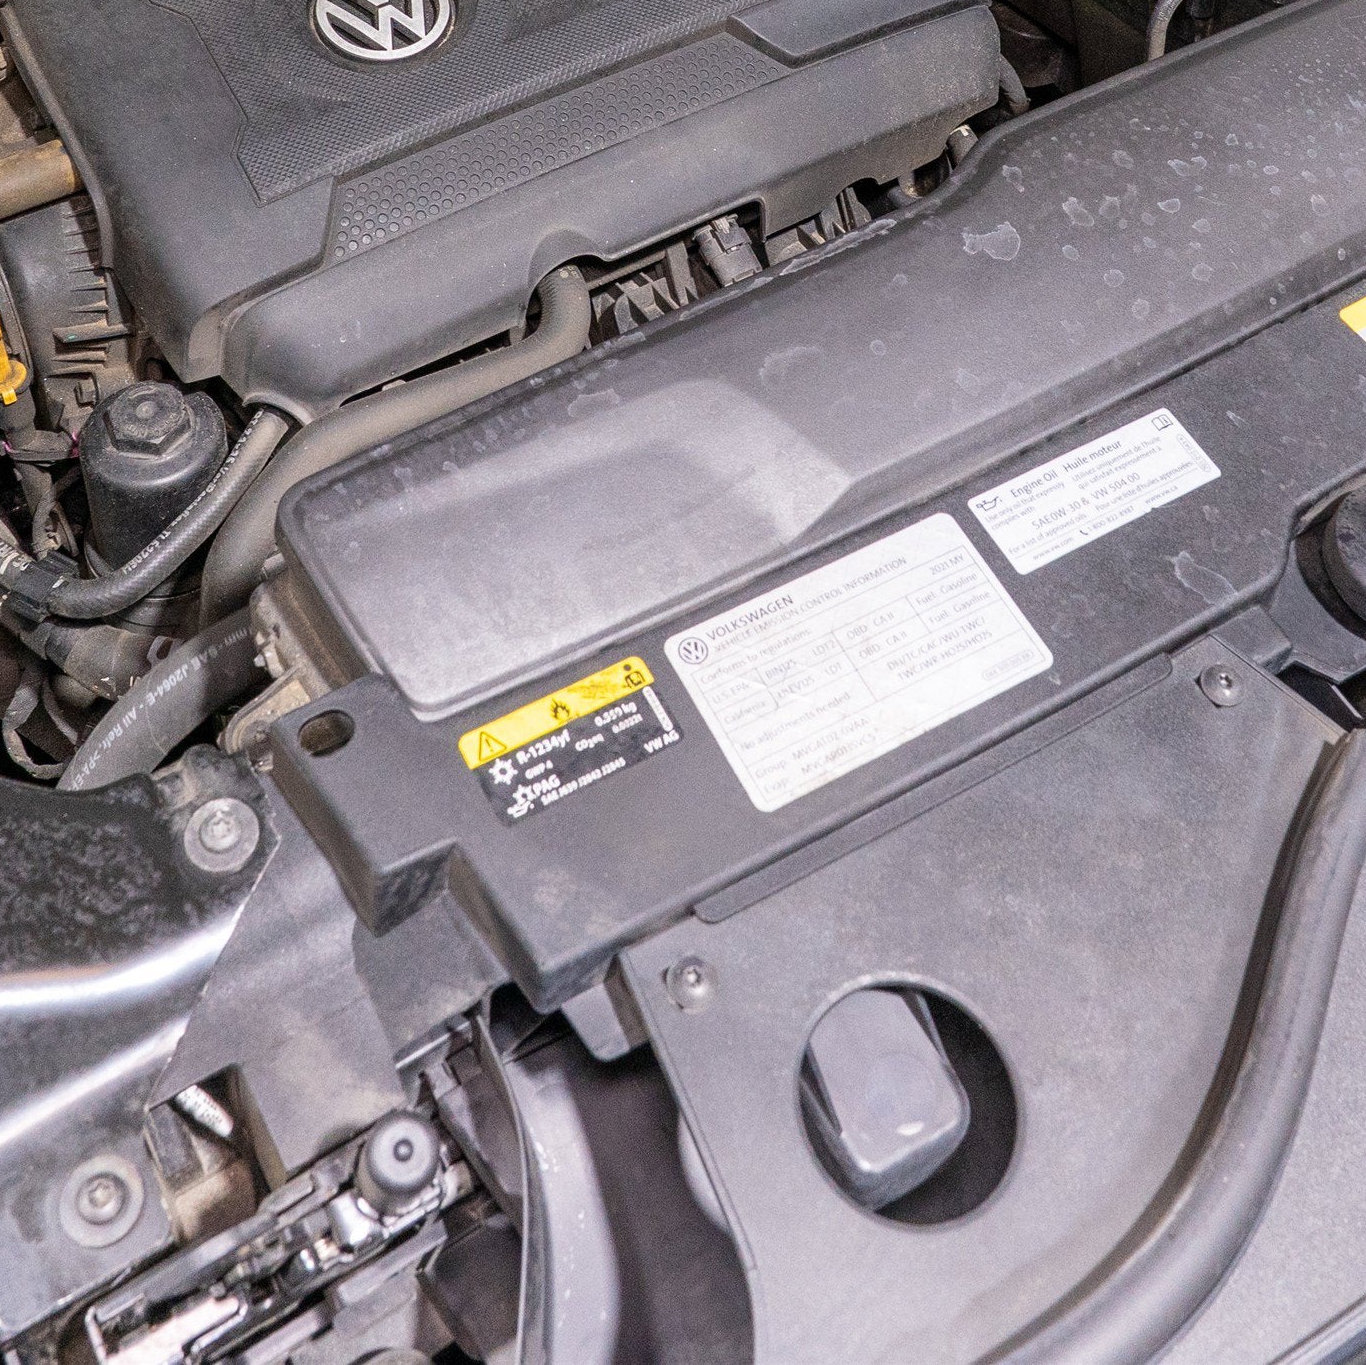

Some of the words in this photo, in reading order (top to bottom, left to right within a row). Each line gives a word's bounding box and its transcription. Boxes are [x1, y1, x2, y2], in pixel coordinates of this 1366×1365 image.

[1131, 443, 1142, 452] de
[1009, 476, 1045, 500] Engine
[1041, 469, 1058, 482] Oil
[1061, 454, 1089, 472] Huile
[1086, 439, 1122, 460] moteur
[997, 505, 1014, 517] only
[1011, 500, 1022, 509] oil
[1020, 494, 1036, 505] that
[1034, 480, 1066, 500] expressly
[1077, 480, 1091, 491] qui
[1079, 496, 1090, 506] &
[1089, 487, 1109, 501] VW
[1107, 477, 1128, 492] 504
[1125, 471, 1141, 483] 00
[990, 512, 1020, 531] complies
[1018, 505, 1035, 516] with
[1095, 500, 1111, 512] Pour
[1008, 544, 1021, 555] For
[1024, 537, 1036, 546] list
[1035, 532, 1045, 541] of
[1042, 517, 1075, 538] approved
[928, 560, 950, 575] 2021
[948, 552, 966, 566] MY
[938, 570, 978, 594] Gasoline
[711, 627, 755, 653] VEHICLE
[752, 606, 800, 634] EMISSION
[798, 586, 843, 612] CONTROL
[841, 556, 908, 591] INFORMATION
[951, 589, 992, 613] Gasoline
[704, 594, 795, 642] VOLKSWAGEN
[698, 656, 747, 685] Conforms
[745, 650, 758, 662] to
[120, 706, 140, 726] All
[739, 738, 756, 752] No
[753, 709, 817, 746] adjustments
[813, 691, 851, 715] needed
[96, 722, 126, 752] Refr.
[513, 728, 573, 768] R-1234yf
[619, 698, 639, 716] kg
[642, 735, 664, 754] VW
[660, 727, 680, 745] AG
[530, 772, 562, 797] PAG
[538, 788, 560, 806] SAE
